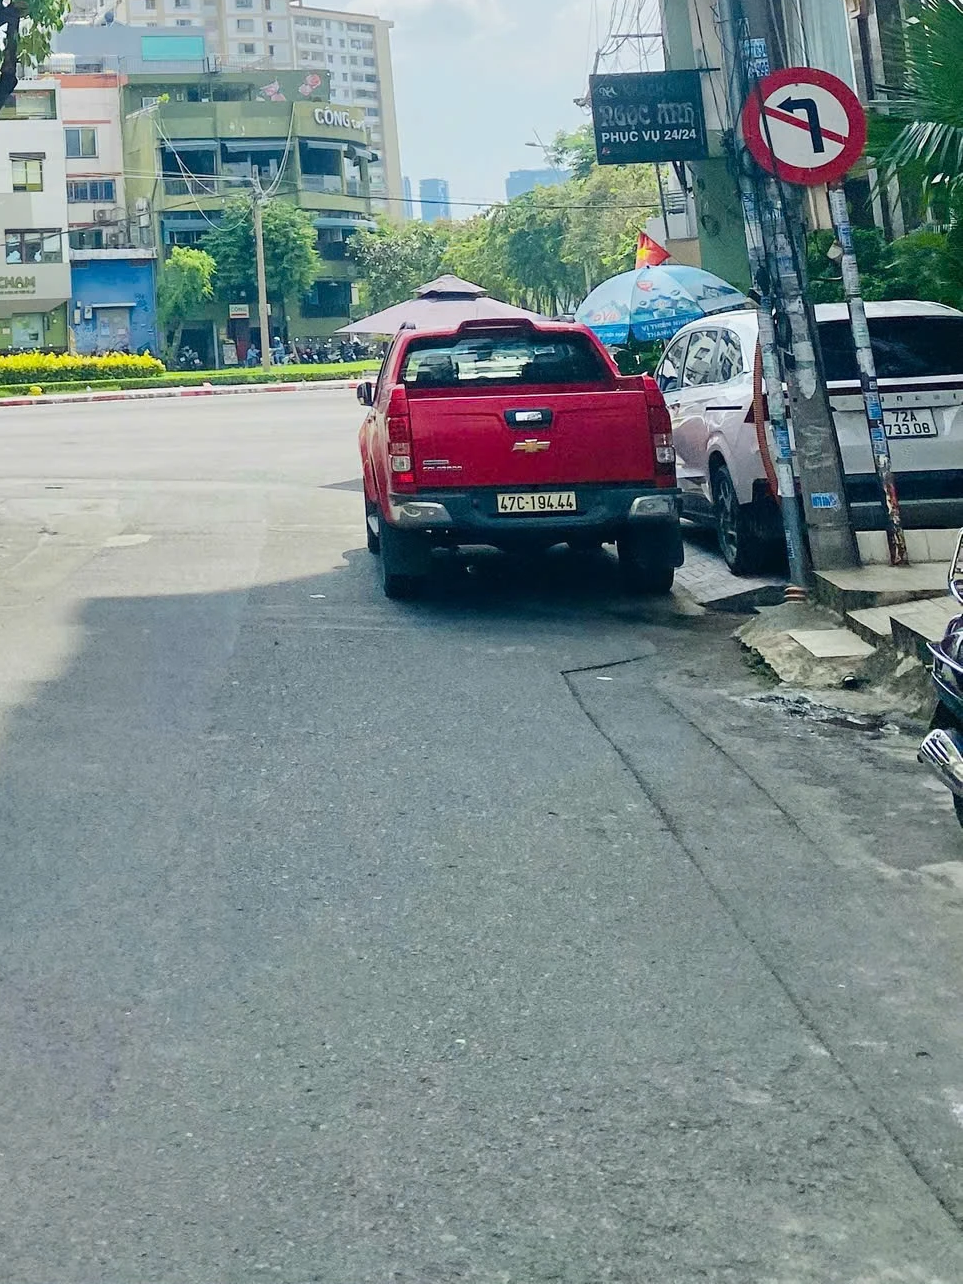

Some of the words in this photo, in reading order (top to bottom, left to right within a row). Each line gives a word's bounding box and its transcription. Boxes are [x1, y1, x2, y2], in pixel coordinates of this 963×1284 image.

[601, 131, 639, 144] PHỤC
[642, 130, 661, 143] VỤ
[664, 128, 696, 141] 24/24
[892, 410, 917, 423] 72A
[884, 423, 930, 435] 733.08
